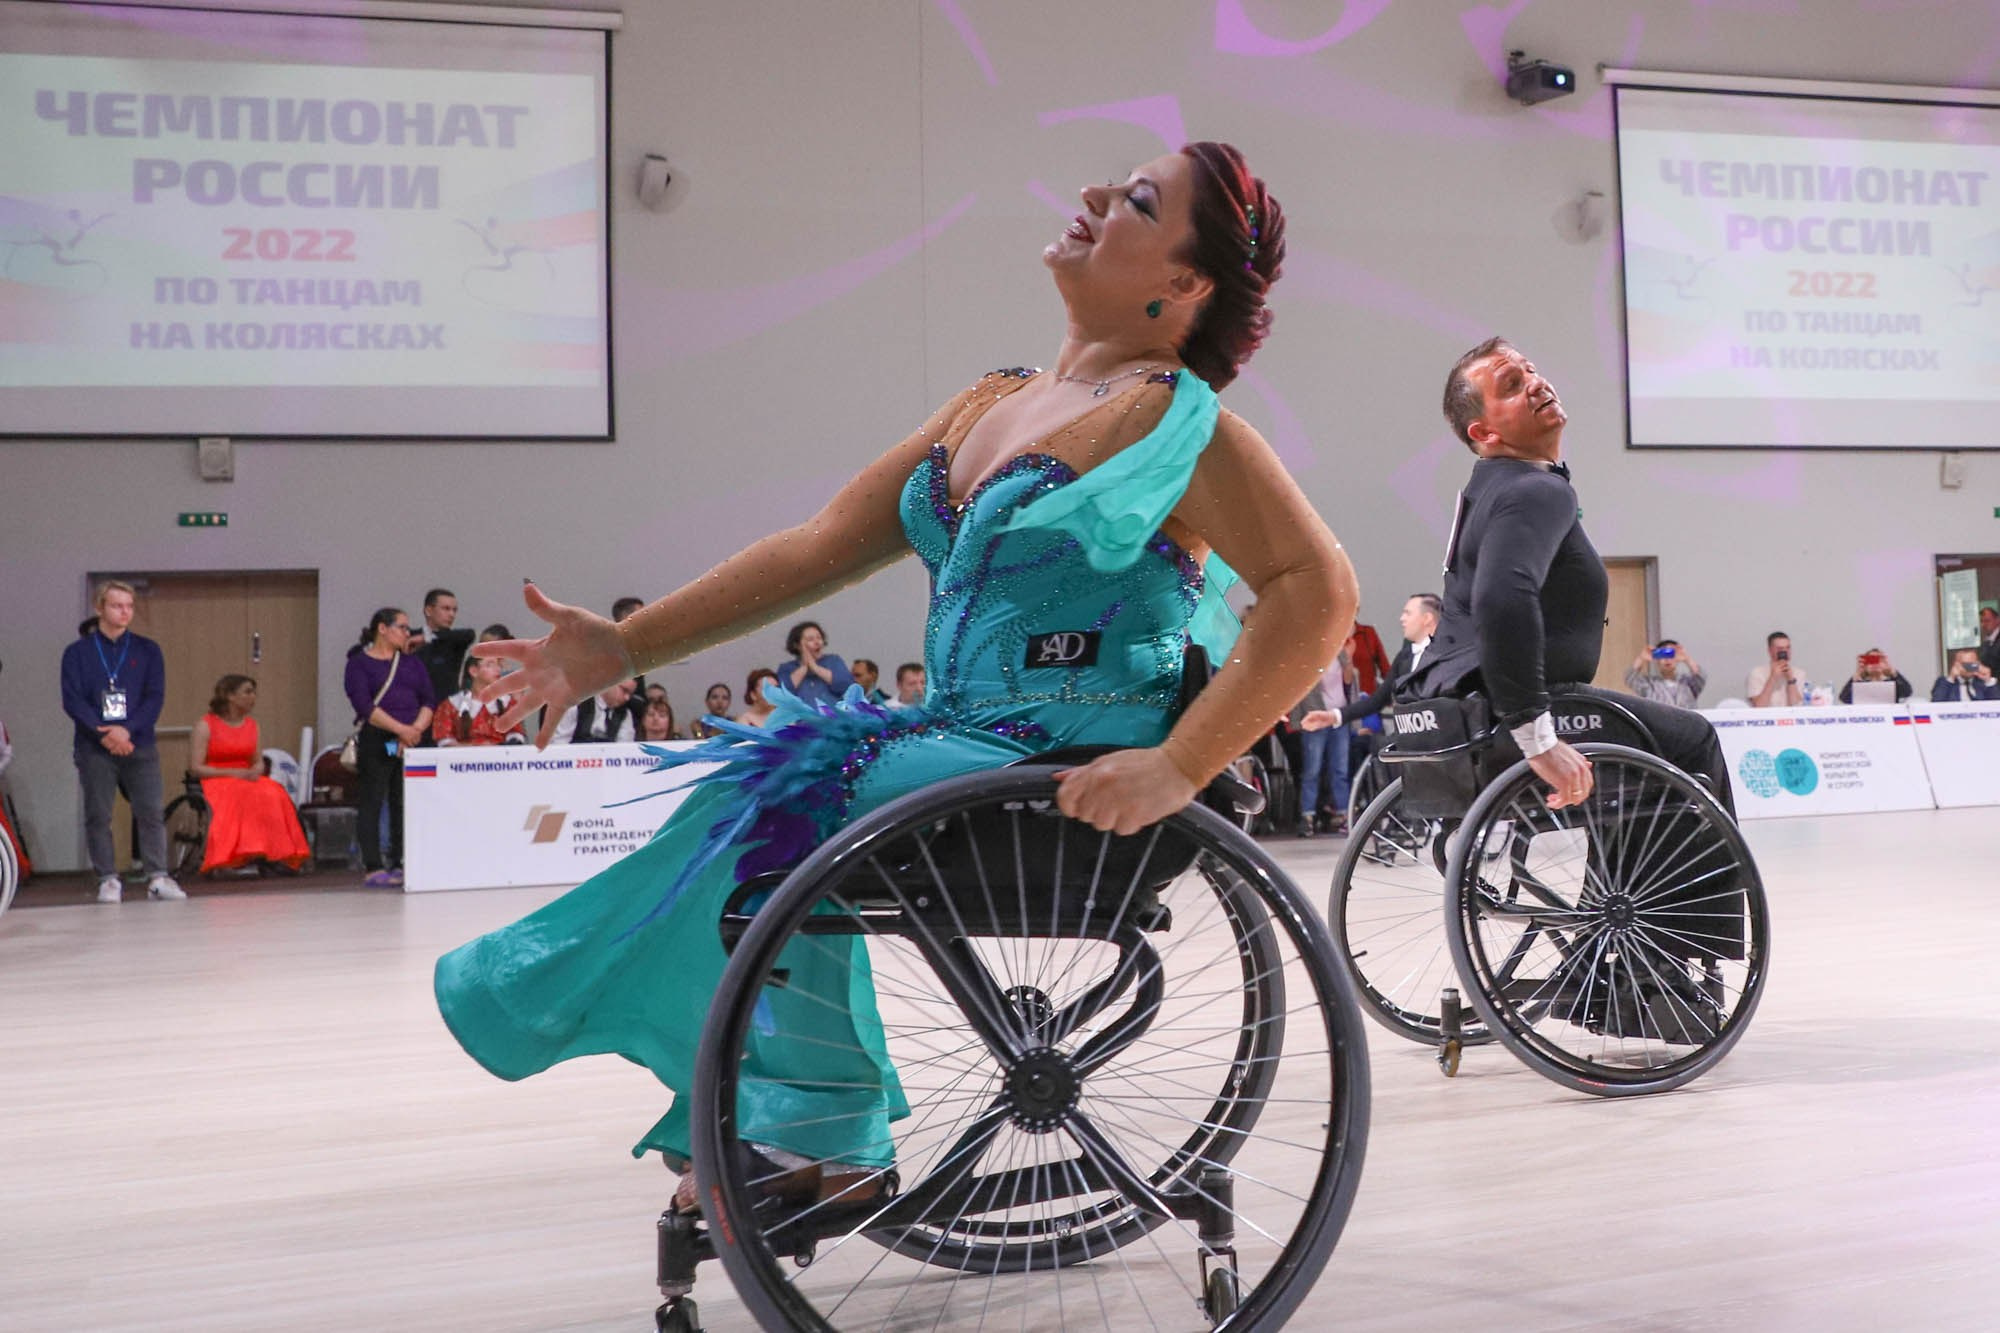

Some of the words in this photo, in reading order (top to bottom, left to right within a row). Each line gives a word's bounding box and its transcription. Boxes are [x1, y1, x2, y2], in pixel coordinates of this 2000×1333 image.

[34, 89, 529, 149] ЧЕМПИОНАТ
[132, 158, 440, 210] РОССИИ
[1658, 158, 1989, 207] ЧЕМПИОНАТ
[221, 228, 357, 263] 2022
[1726, 213, 1932, 256] РОССИИ
[155, 278, 215, 305] ПО
[228, 278, 422, 310] ТАНЦАМ
[1787, 270, 1878, 298] 2022
[129, 322, 194, 350] НА
[205, 322, 446, 350] КОЛЯСКАХ
[1744, 310, 1788, 333] ПО
[1795, 311, 1922, 337] ТАНЦАМ
[1730, 346, 1772, 368] НА
[1779, 347, 1941, 370] КОЛЯСКАХ
[1395, 710, 1439, 734] LUKOR
[1553, 714, 1603, 731] KOR
[450, 761, 524, 773] ЧЕМПИОНАТ
[527, 760, 573, 771] РОССИИ
[576, 759, 603, 769] 2022
[606, 758, 622, 768] ПО
[625, 757, 660, 768] ТАНЦА
[573, 818, 614, 828] ФОНД
[573, 829, 654, 842] ПРЕЗИДЕНТ
[574, 843, 637, 855] ГРАНТОВ
